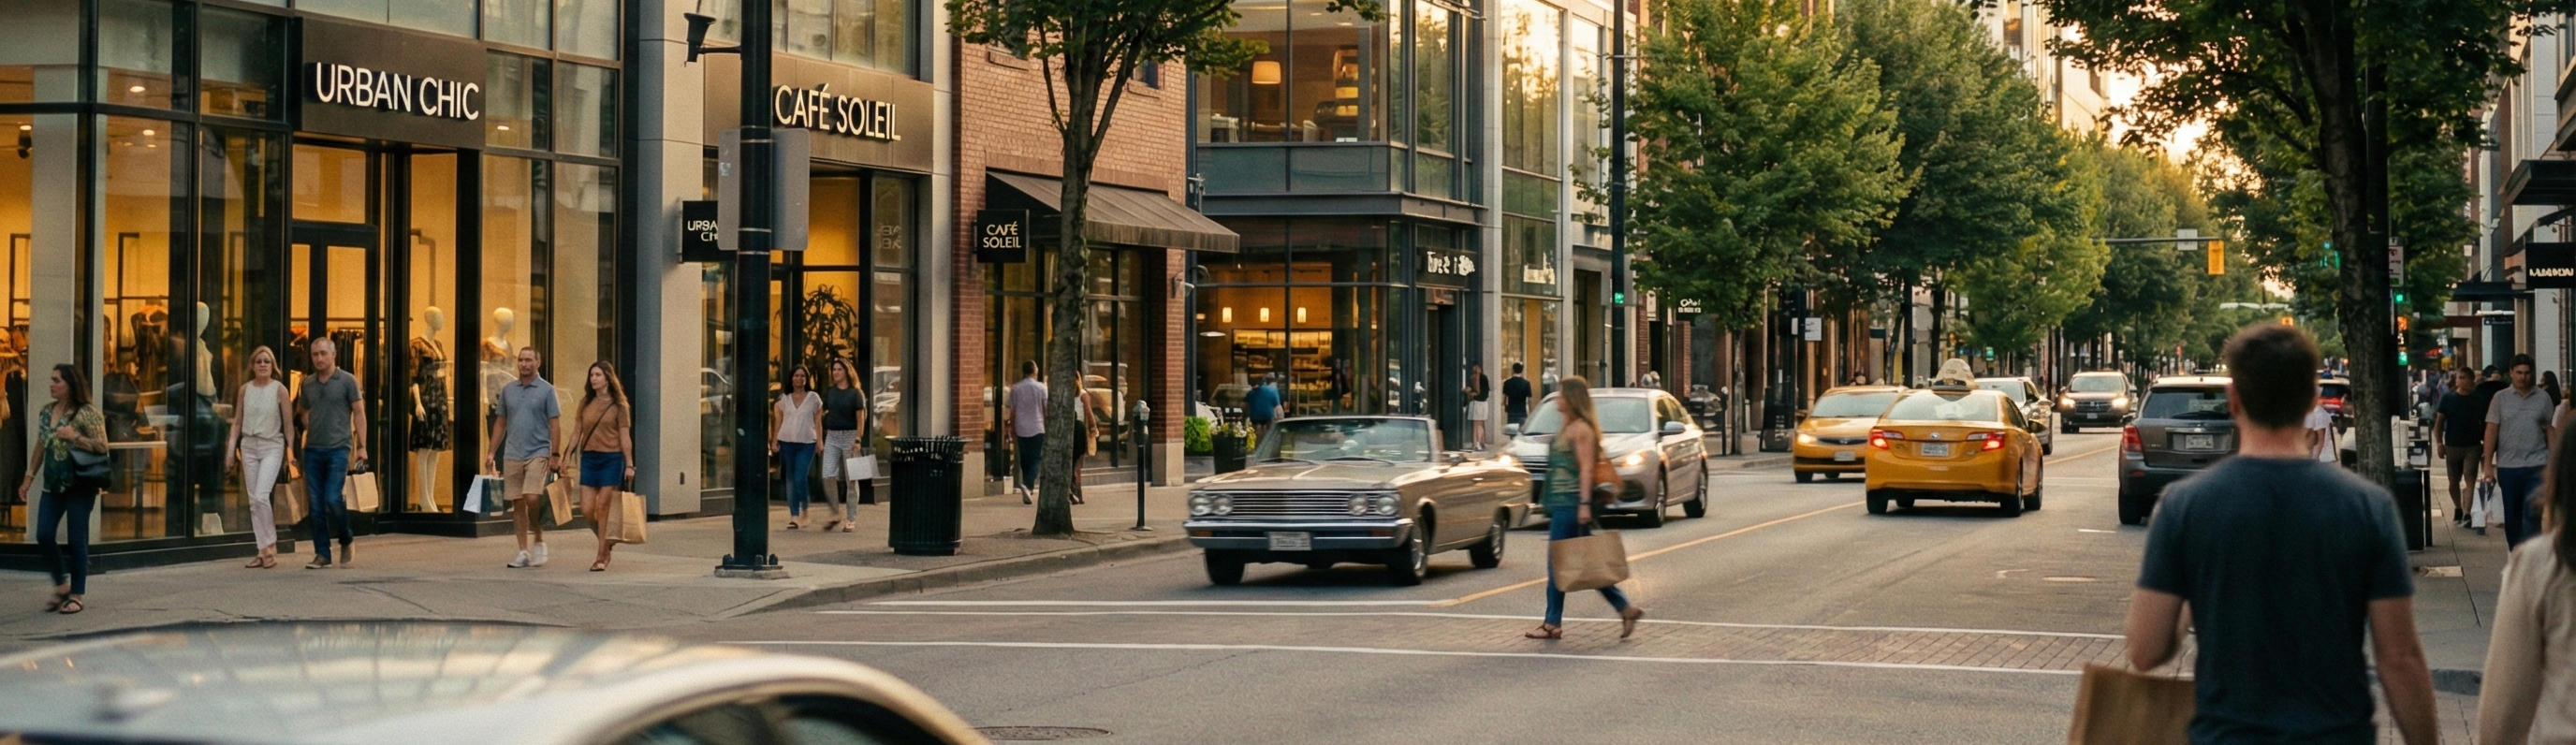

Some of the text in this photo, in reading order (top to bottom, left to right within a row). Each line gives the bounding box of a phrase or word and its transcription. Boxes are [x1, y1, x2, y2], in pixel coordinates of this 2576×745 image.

[316, 62, 479, 121] URBAN CHIC
[775, 82, 901, 141] CAFÉ SOLEIL
[983, 236, 1022, 249] SOLEIL
[986, 221, 1018, 236] CAFÉ
